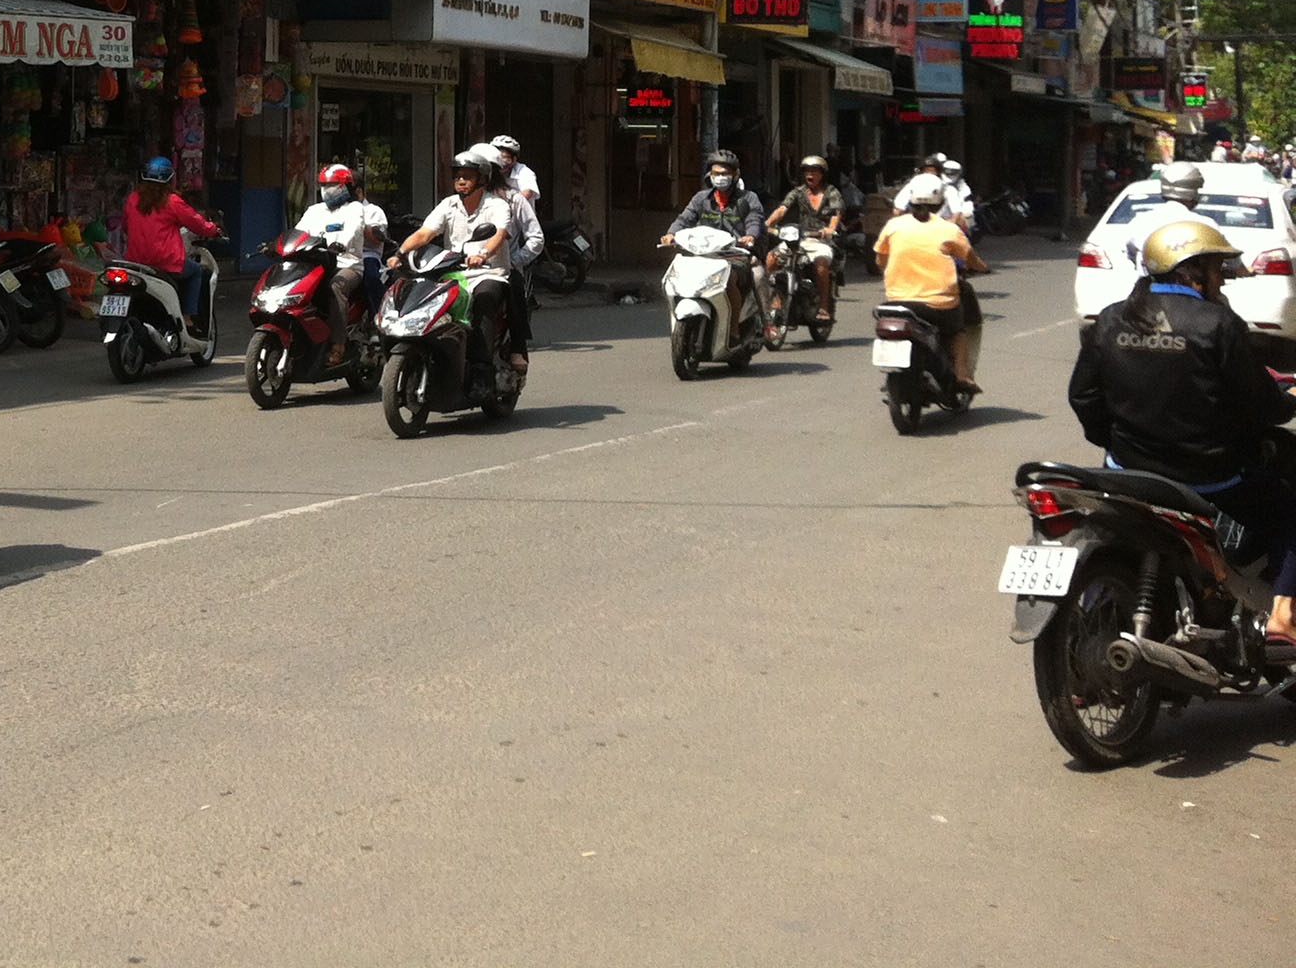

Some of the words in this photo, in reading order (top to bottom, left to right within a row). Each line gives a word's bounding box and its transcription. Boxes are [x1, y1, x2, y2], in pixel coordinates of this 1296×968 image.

[36, 21, 94, 59] NGA
[102, 25, 126, 41] 30
[1116, 330, 1187, 350] adidas
